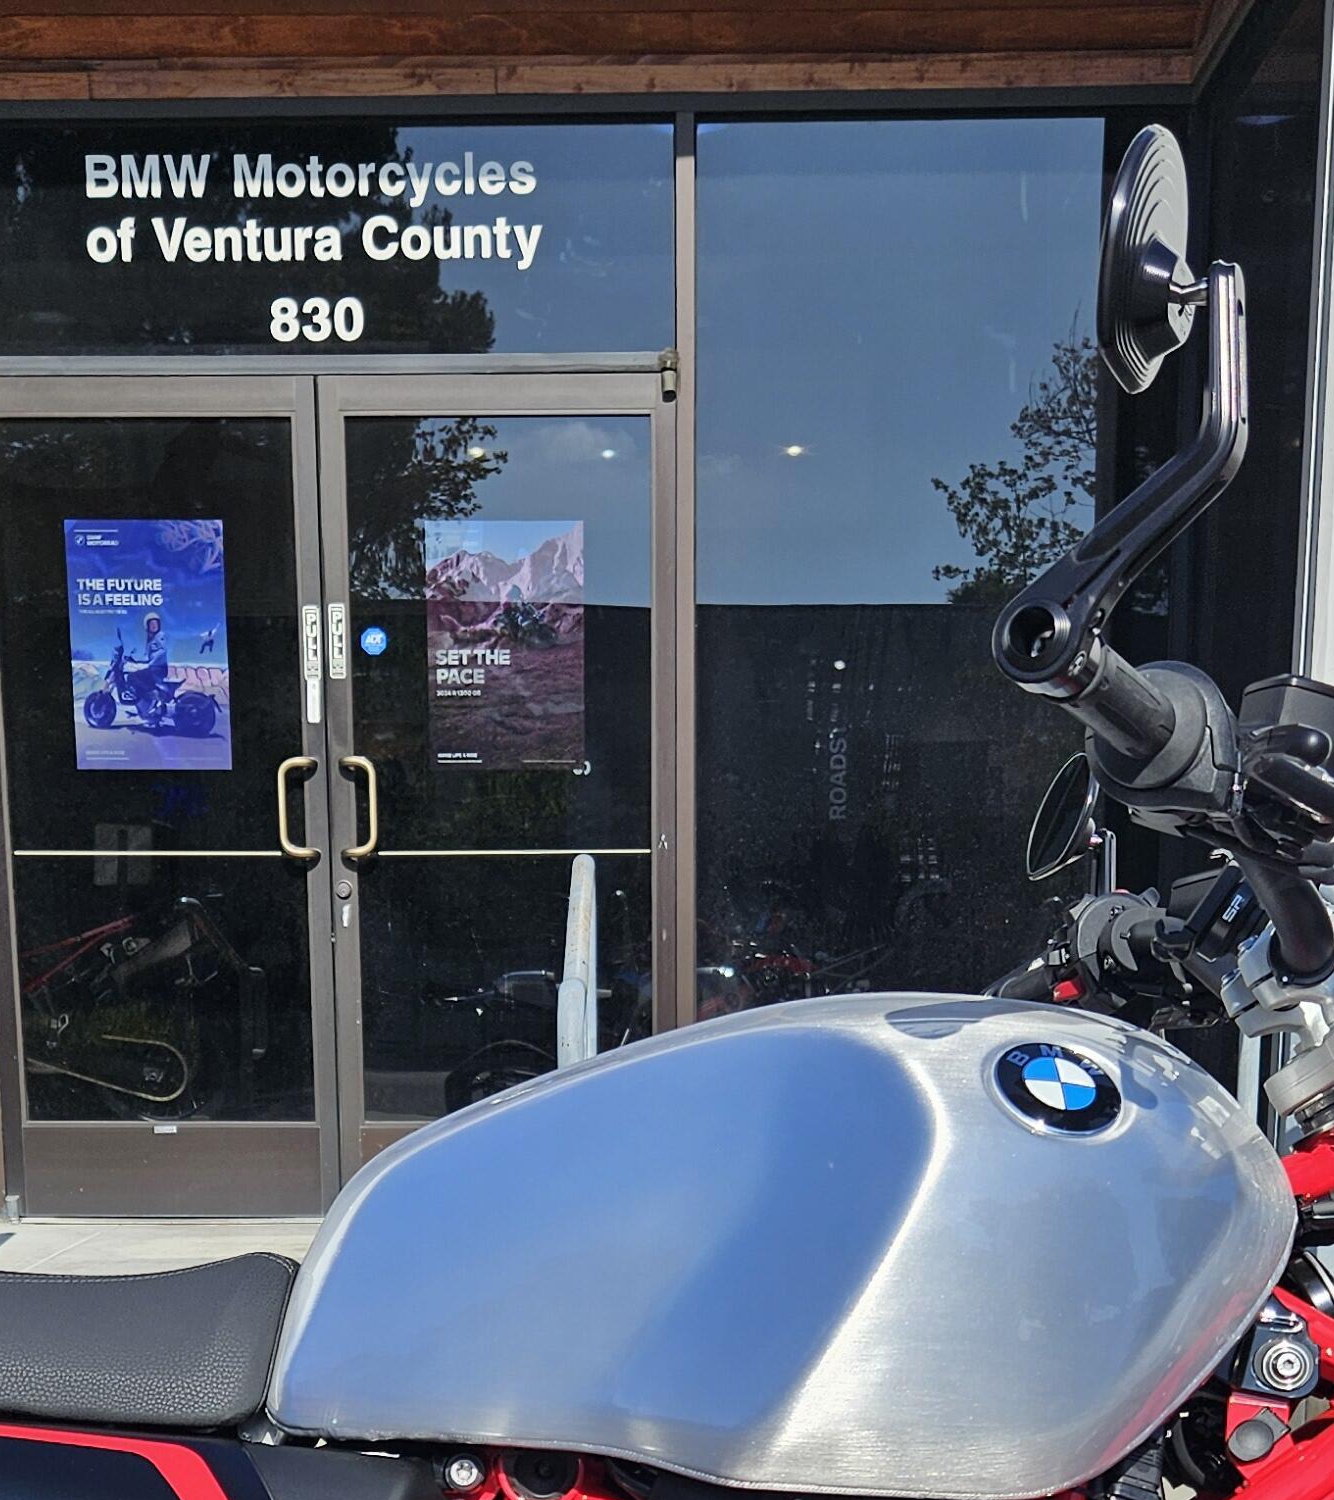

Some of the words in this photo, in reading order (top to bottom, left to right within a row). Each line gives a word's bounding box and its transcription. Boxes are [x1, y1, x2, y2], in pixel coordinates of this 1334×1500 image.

[84, 154, 211, 199] BMW
[234, 152, 537, 208] Motorcycles
[85, 217, 136, 264] of
[151, 217, 344, 263] Ventura
[362, 215, 544, 271] County
[270, 297, 365, 343] 830
[77, 578, 105, 591] THE
[107, 578, 162, 591] FUTURE
[78, 593, 91, 606] IS
[92, 593, 104, 606] A
[105, 593, 163, 606] FEELING
[306, 613, 317, 661] PULL
[331, 611, 342, 659] PULL
[435, 649, 470, 665] SET
[472, 649, 511, 665] THE
[436, 668, 485, 685] PACE
[1005, 1044, 1105, 1077] BMW
